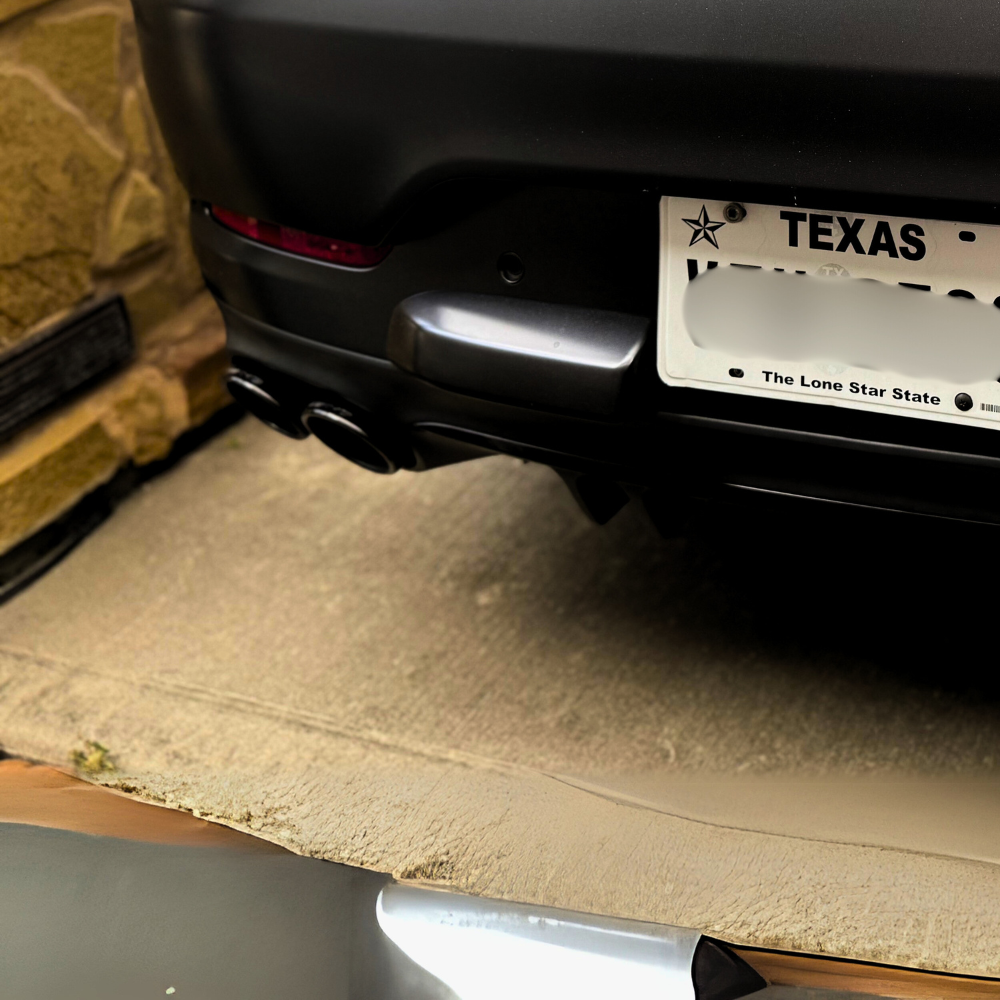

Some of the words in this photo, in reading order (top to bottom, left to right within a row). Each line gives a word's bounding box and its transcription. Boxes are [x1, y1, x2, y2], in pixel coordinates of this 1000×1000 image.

[779, 210, 926, 261] TEXAS
[761, 370, 795, 386] The
[800, 375, 843, 392] Lone
[849, 381, 887, 398] Star
[892, 387, 941, 406] State
